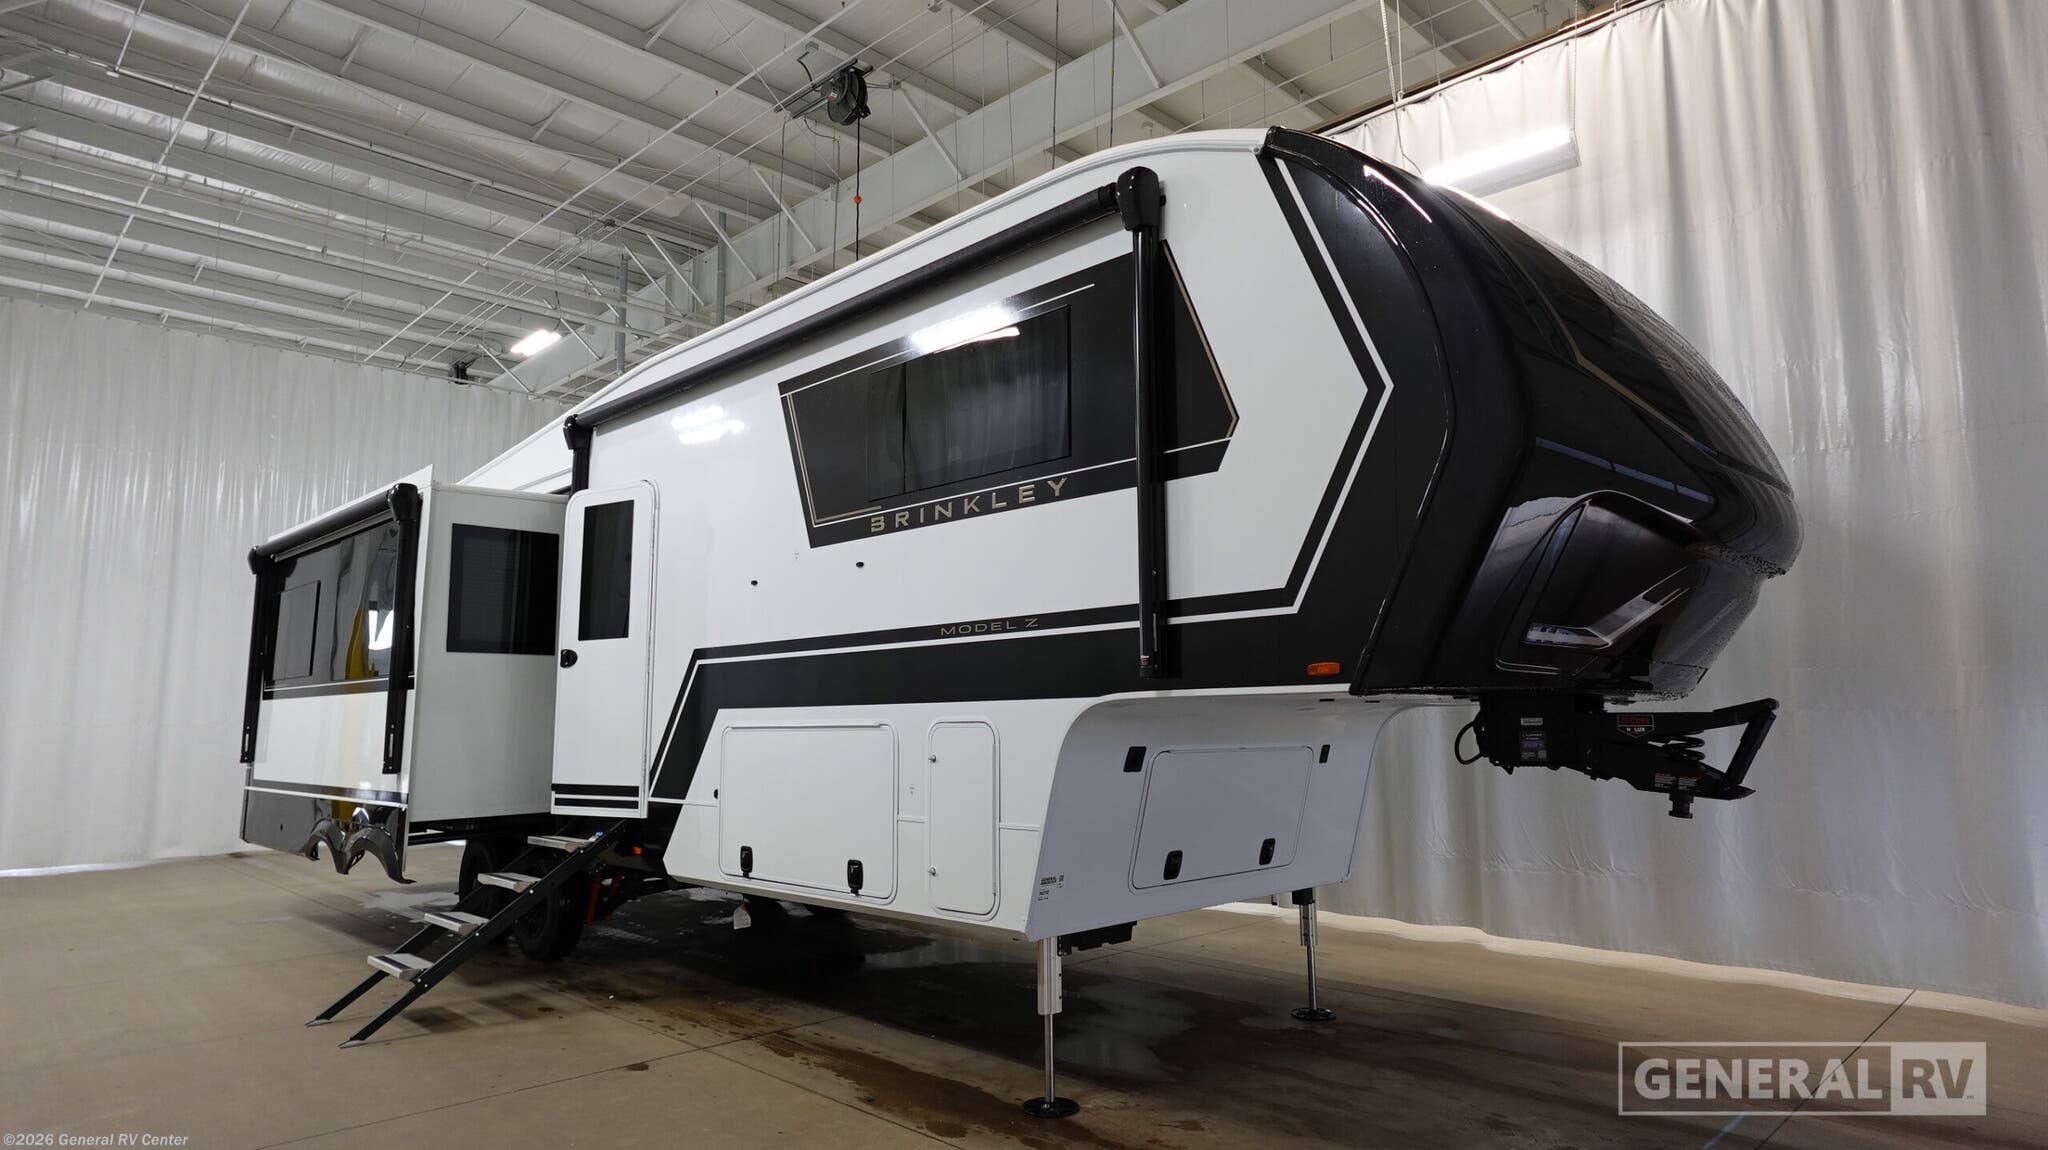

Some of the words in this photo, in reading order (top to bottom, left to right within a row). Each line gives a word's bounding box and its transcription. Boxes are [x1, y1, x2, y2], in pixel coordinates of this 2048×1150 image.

[870, 477, 1069, 533] BRINKLEY
[940, 620, 1017, 636] MODEL
[1025, 617, 1039, 628] Z
